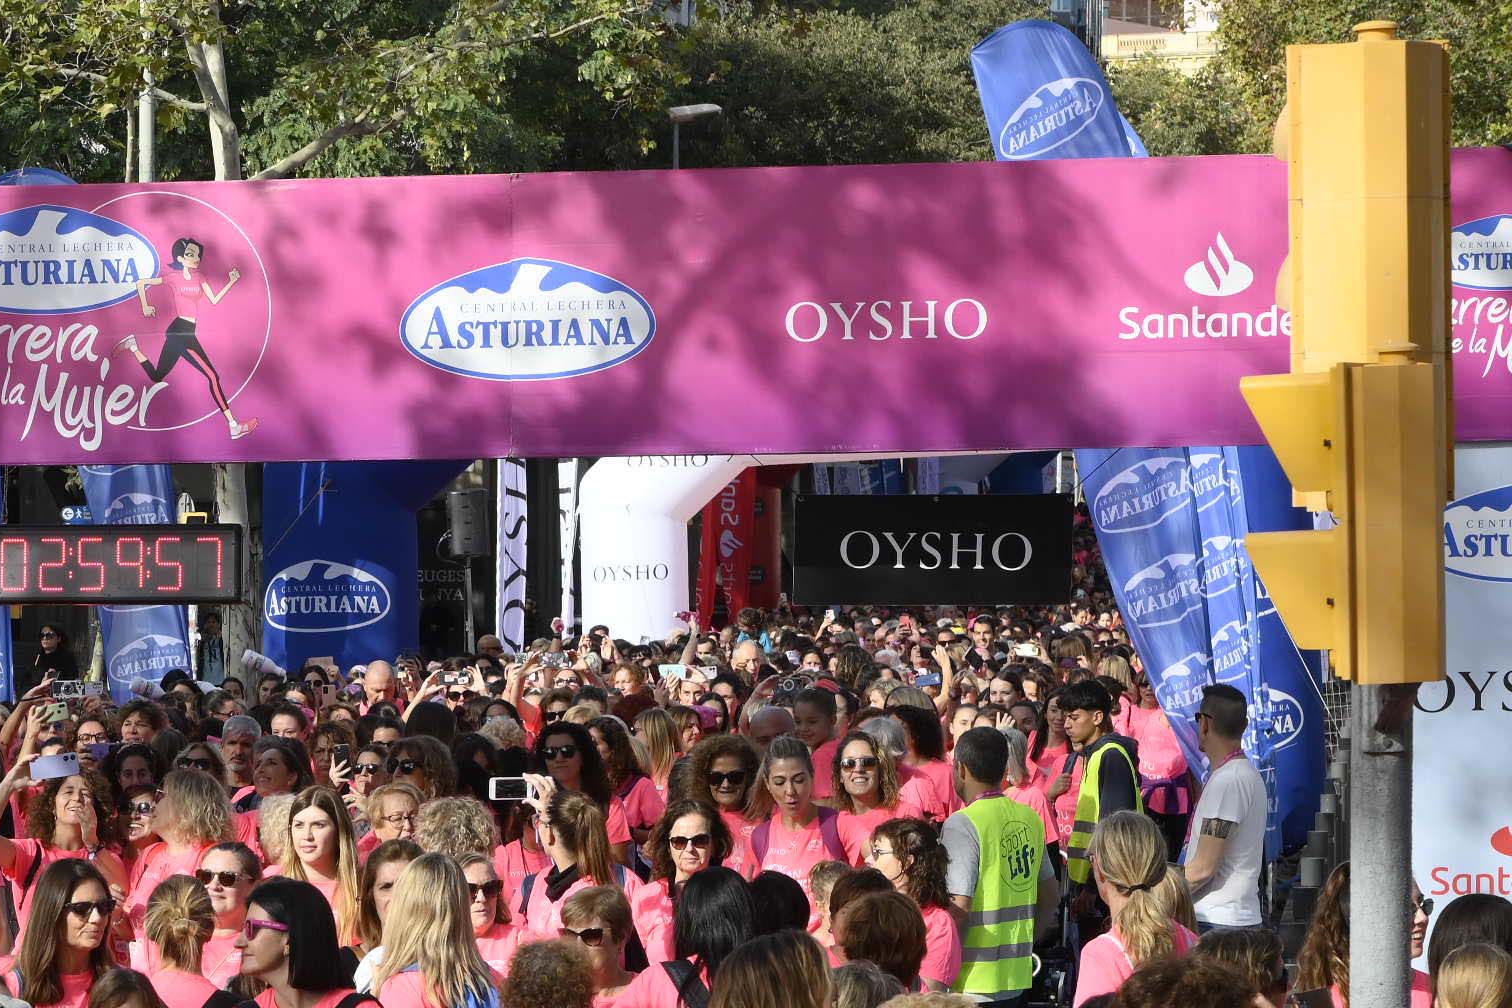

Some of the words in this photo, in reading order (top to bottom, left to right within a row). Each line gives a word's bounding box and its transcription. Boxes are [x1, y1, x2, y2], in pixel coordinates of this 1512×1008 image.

[63, 240, 134, 253] LECHERA
[459, 300, 539, 313] CENTRAL
[546, 298, 627, 312] LECHERA
[784, 298, 987, 342] OYSHO
[1119, 305, 1292, 340] Santande
[420, 305, 635, 350] ASTURIANA
[1468, 328, 1487, 354] la
[0, 367, 25, 407] la
[21, 357, 169, 451] Mujer
[0, 536, 223, 592] 02:59:57
[502, 458, 528, 651] OYSH
[840, 530, 1033, 571] OYSHO
[281, 584, 322, 593] CENTRAL
[328, 584, 377, 593] LECHERA
[592, 562, 669, 583] OYSHO
[268, 589, 381, 616] ASTURIANA
[1414, 669, 1512, 713] OYS
[1431, 866, 1512, 896] Sant
